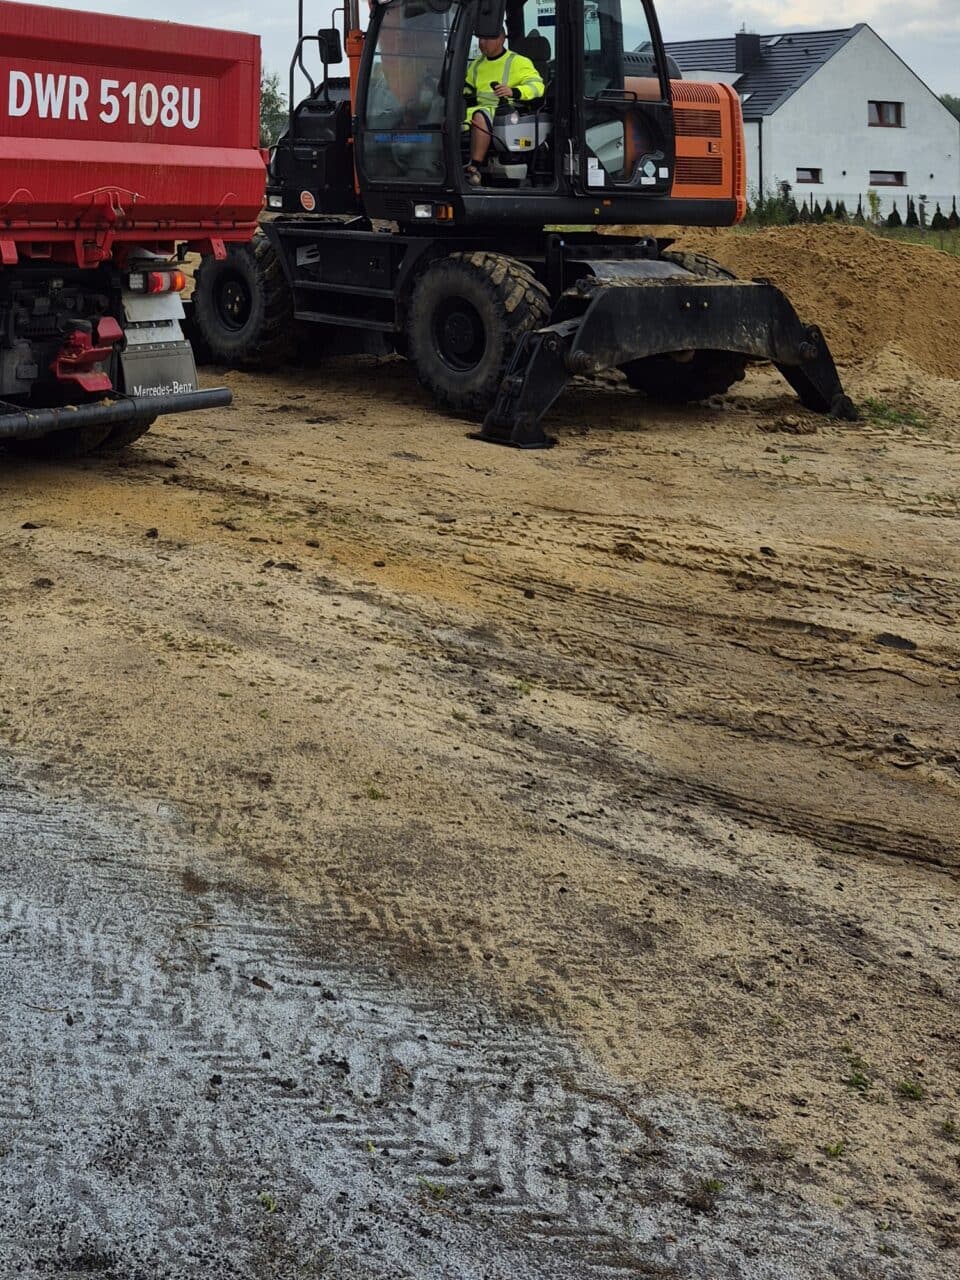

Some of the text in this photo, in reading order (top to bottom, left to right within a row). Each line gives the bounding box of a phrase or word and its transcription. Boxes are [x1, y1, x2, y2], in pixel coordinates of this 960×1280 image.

[8, 70, 201, 129] DWR 5108U
[133, 381, 193, 397] Mercedes-Benz
